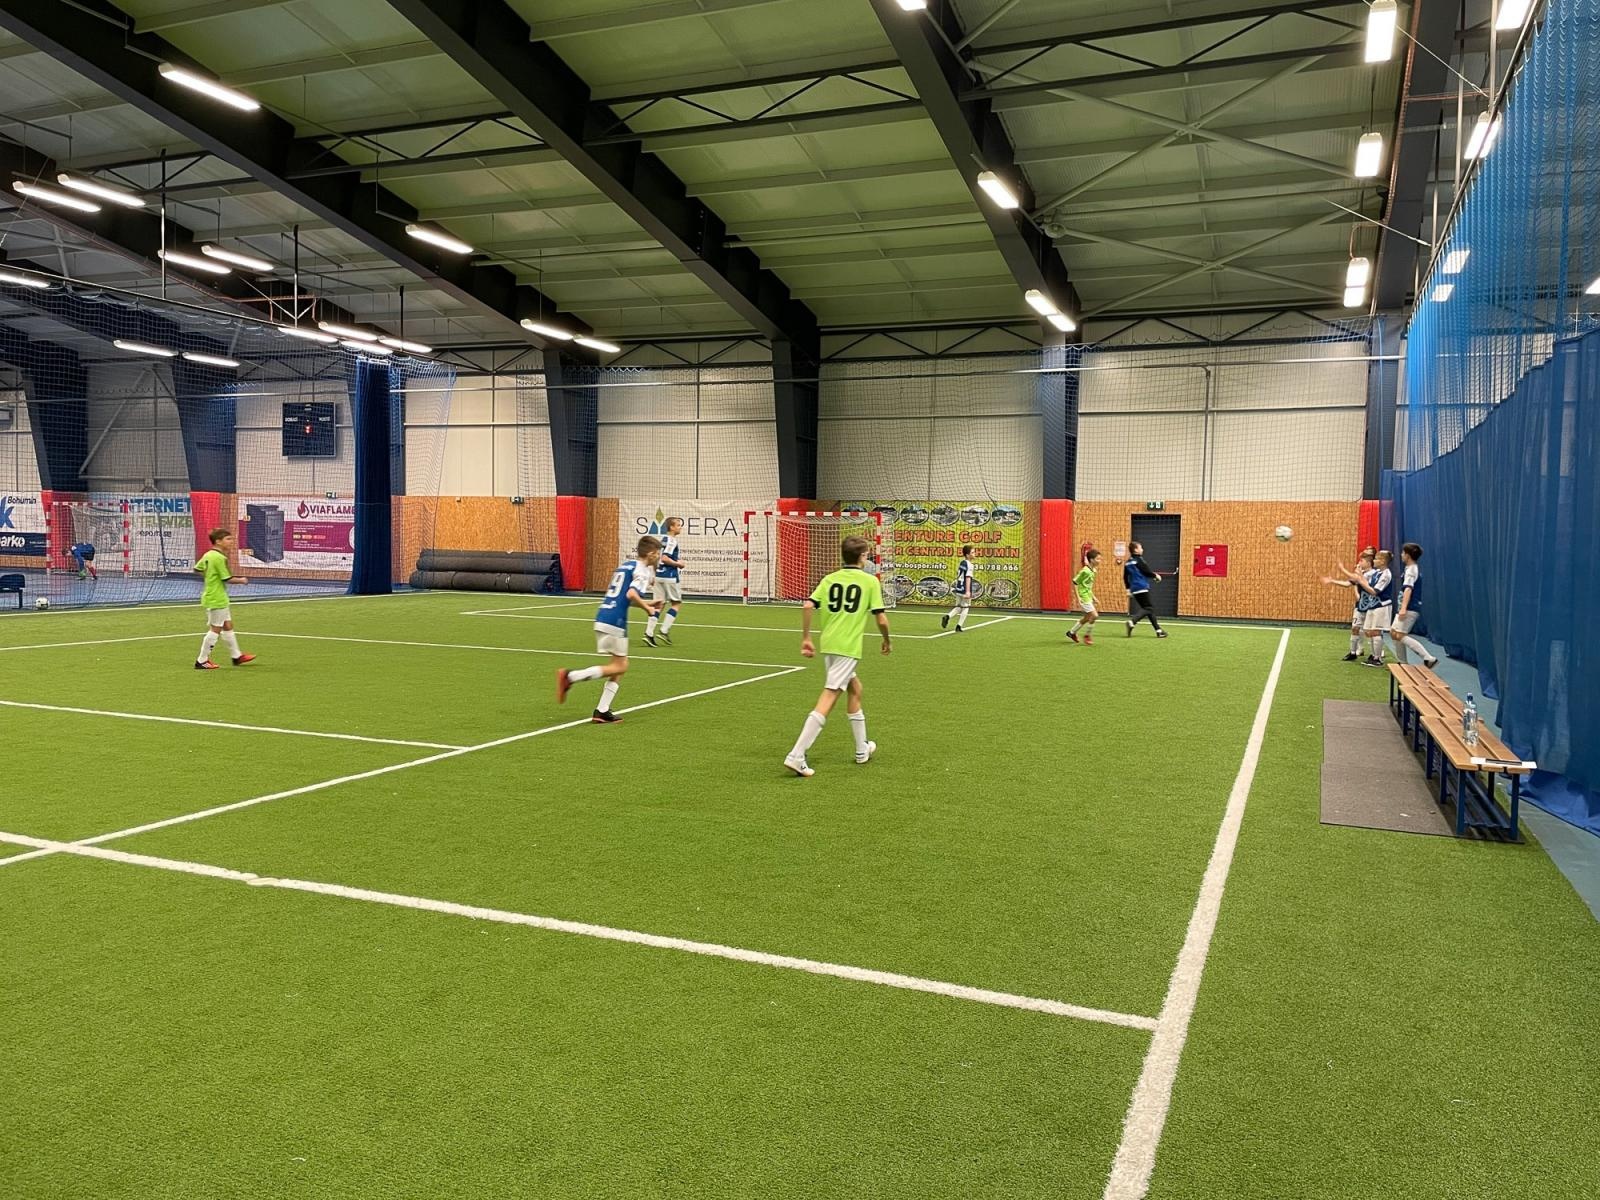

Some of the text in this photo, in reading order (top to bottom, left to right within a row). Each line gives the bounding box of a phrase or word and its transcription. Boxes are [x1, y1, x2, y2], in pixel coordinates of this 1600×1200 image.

[959, 530, 1002, 543] GOLF
[906, 546, 954, 558] CENTRU
[957, 546, 1020, 558] BHUMÍN
[828, 583, 862, 613] 99
